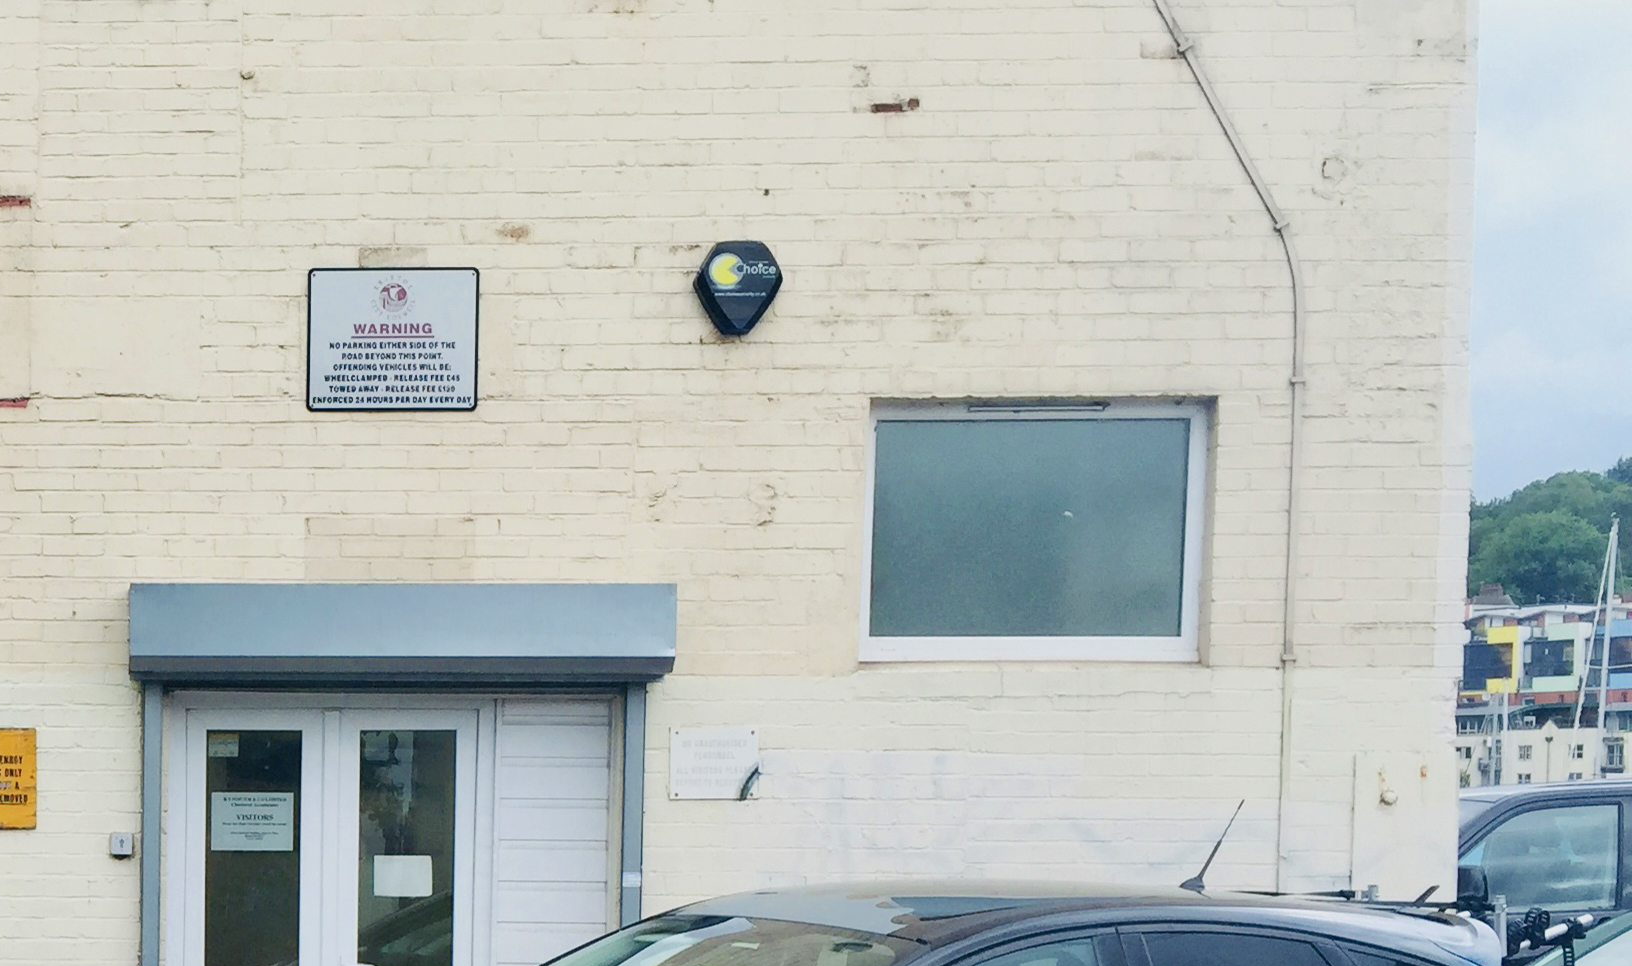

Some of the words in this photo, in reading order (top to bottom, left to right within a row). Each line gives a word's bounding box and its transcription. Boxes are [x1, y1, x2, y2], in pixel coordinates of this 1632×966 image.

[734, 263, 776, 274] Choice
[353, 323, 433, 334] WARNING
[329, 341, 341, 350] NO
[342, 341, 377, 350] PARKING
[379, 341, 407, 350] EITHER
[409, 341, 427, 350] SIDE
[428, 341, 439, 350] OF
[441, 341, 456, 350] THE
[341, 352, 363, 360] ROAD
[365, 352, 397, 360] BEYOND
[399, 352, 416, 360] THIS
[333, 363, 377, 371] OFFENDING
[379, 363, 417, 371] VEHICLES
[419, 363, 437, 371] WILL
[324, 374, 388, 382] WHEELCLAMPED
[393, 374, 428, 382] RELEASE
[430, 374, 444, 382] FEE
[446, 374, 460, 382] £45
[329, 385, 357, 393] TOWED
[358, 385, 379, 393] AWAY
[385, 385, 420, 393] RELEASE
[422, 385, 435, 393] FEE
[312, 396, 354, 404] ENFORCED
[355, 396, 365, 404] 24
[366, 396, 394, 404] HOURS
[395, 396, 410, 404] PER
[412, 396, 428, 404] DAY
[429, 396, 454, 404] EVERY
[456, 396, 472, 404] DAY
[4, 768, 23, 777] ONLY
[15, 781, 20, 790] A
[236, 813, 274, 821] VISITORS
